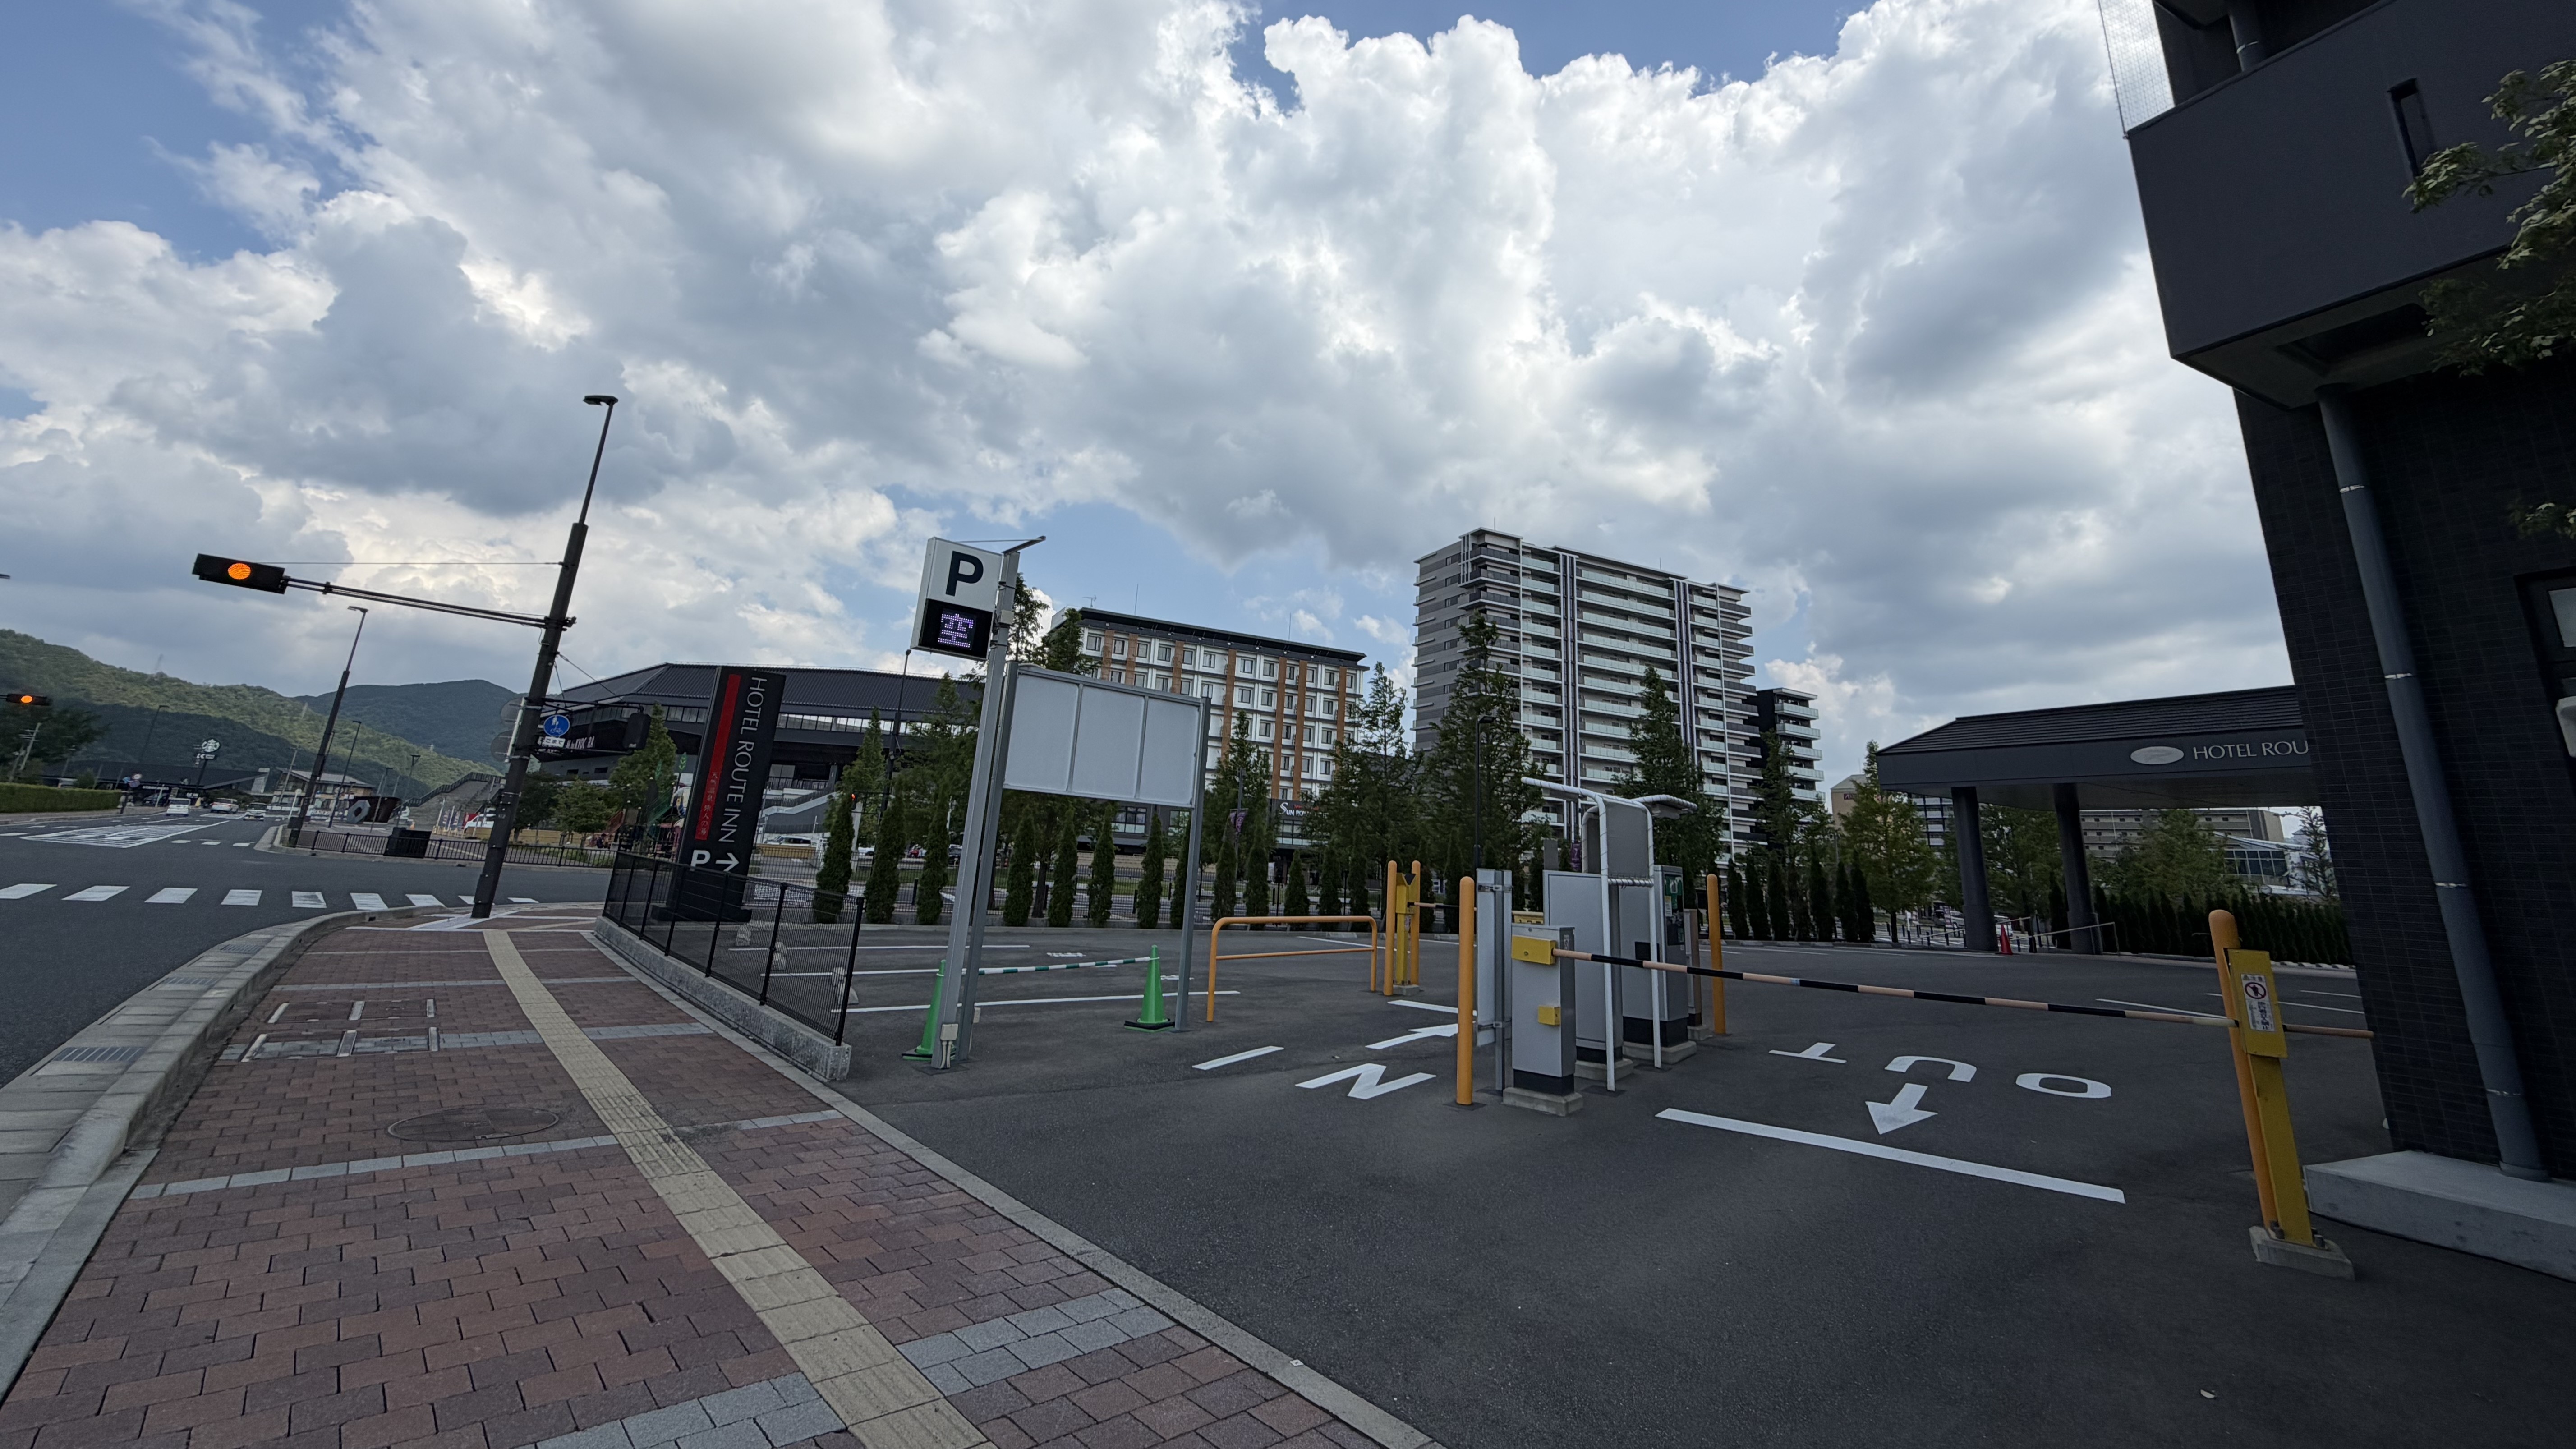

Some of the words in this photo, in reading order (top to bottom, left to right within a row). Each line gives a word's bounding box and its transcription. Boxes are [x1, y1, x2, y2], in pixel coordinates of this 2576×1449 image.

[946, 550, 984, 597] P
[938, 613, 974, 648] 空
[740, 677, 767, 735] HOTEL
[726, 740, 754, 803] ROUTE
[2193, 743, 2257, 759] HOTEL
[718, 808, 741, 843] INN
[690, 850, 711, 871] P
[1768, 1042, 2112, 1099] OUT
